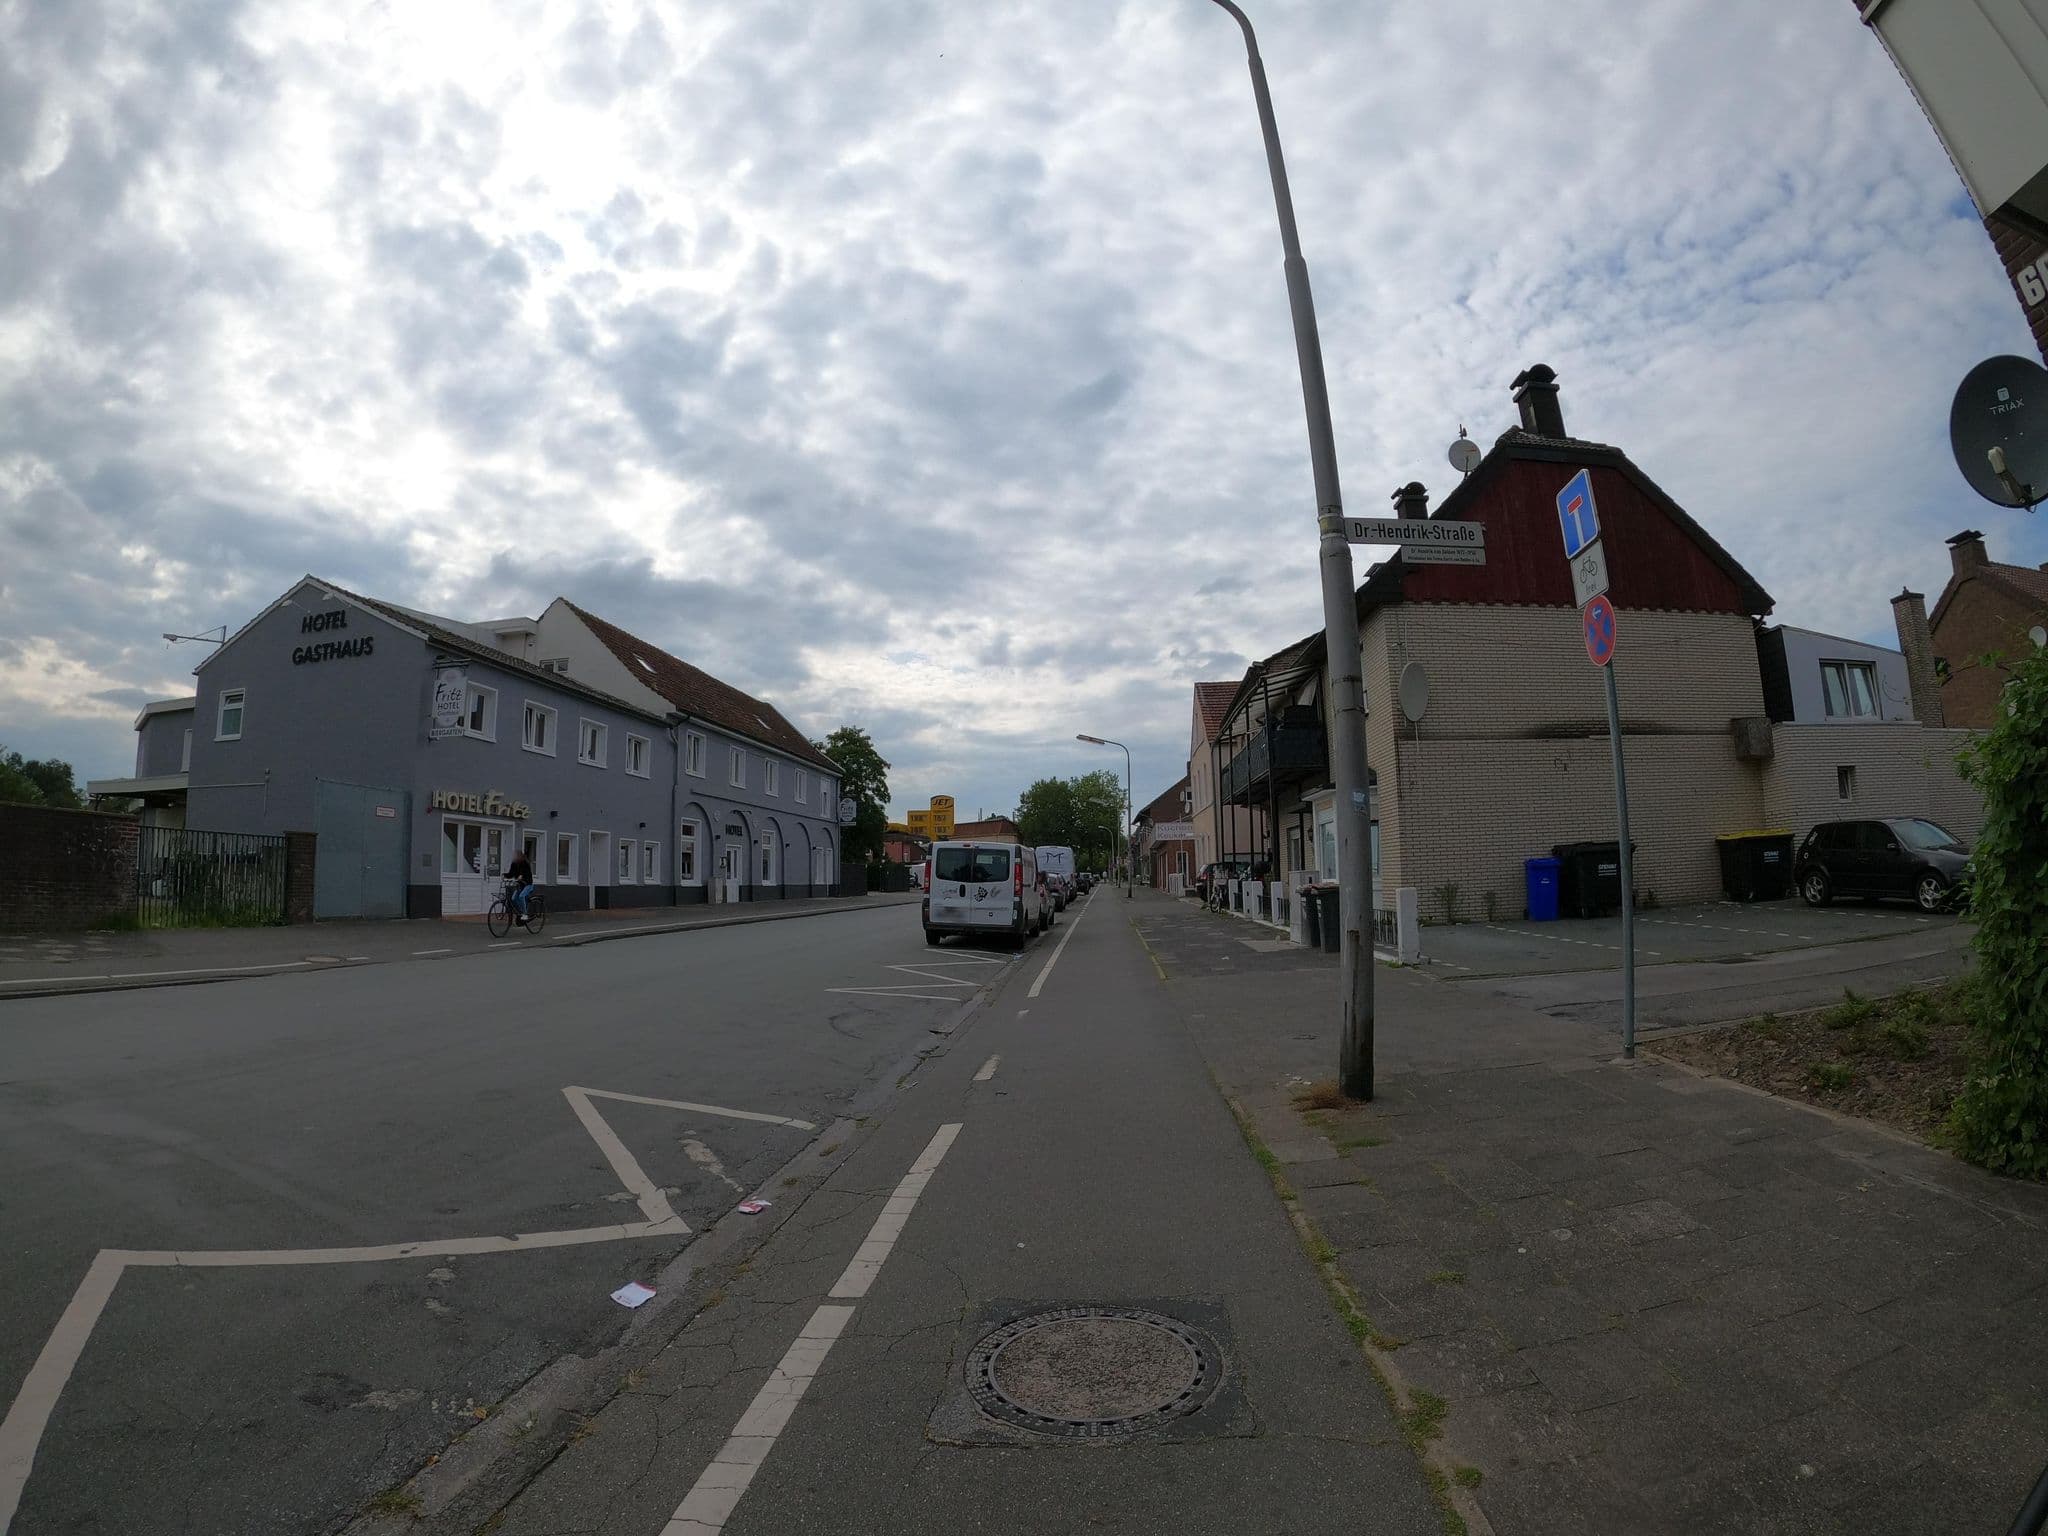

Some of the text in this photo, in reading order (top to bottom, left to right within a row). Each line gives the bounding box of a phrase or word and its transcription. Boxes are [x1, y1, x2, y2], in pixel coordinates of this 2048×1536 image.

[1989, 398, 2025, 415] TRIAX
[1354, 522, 1476, 541] Dr.-Hendrik-Straße
[301, 610, 348, 633] HOTEL
[292, 636, 374, 665] GASTHAUS
[435, 683, 463, 702] Fritz
[437, 702, 460, 711] HOTEL
[432, 789, 530, 818] HOTEL Fritz
[933, 798, 949, 806] JET
